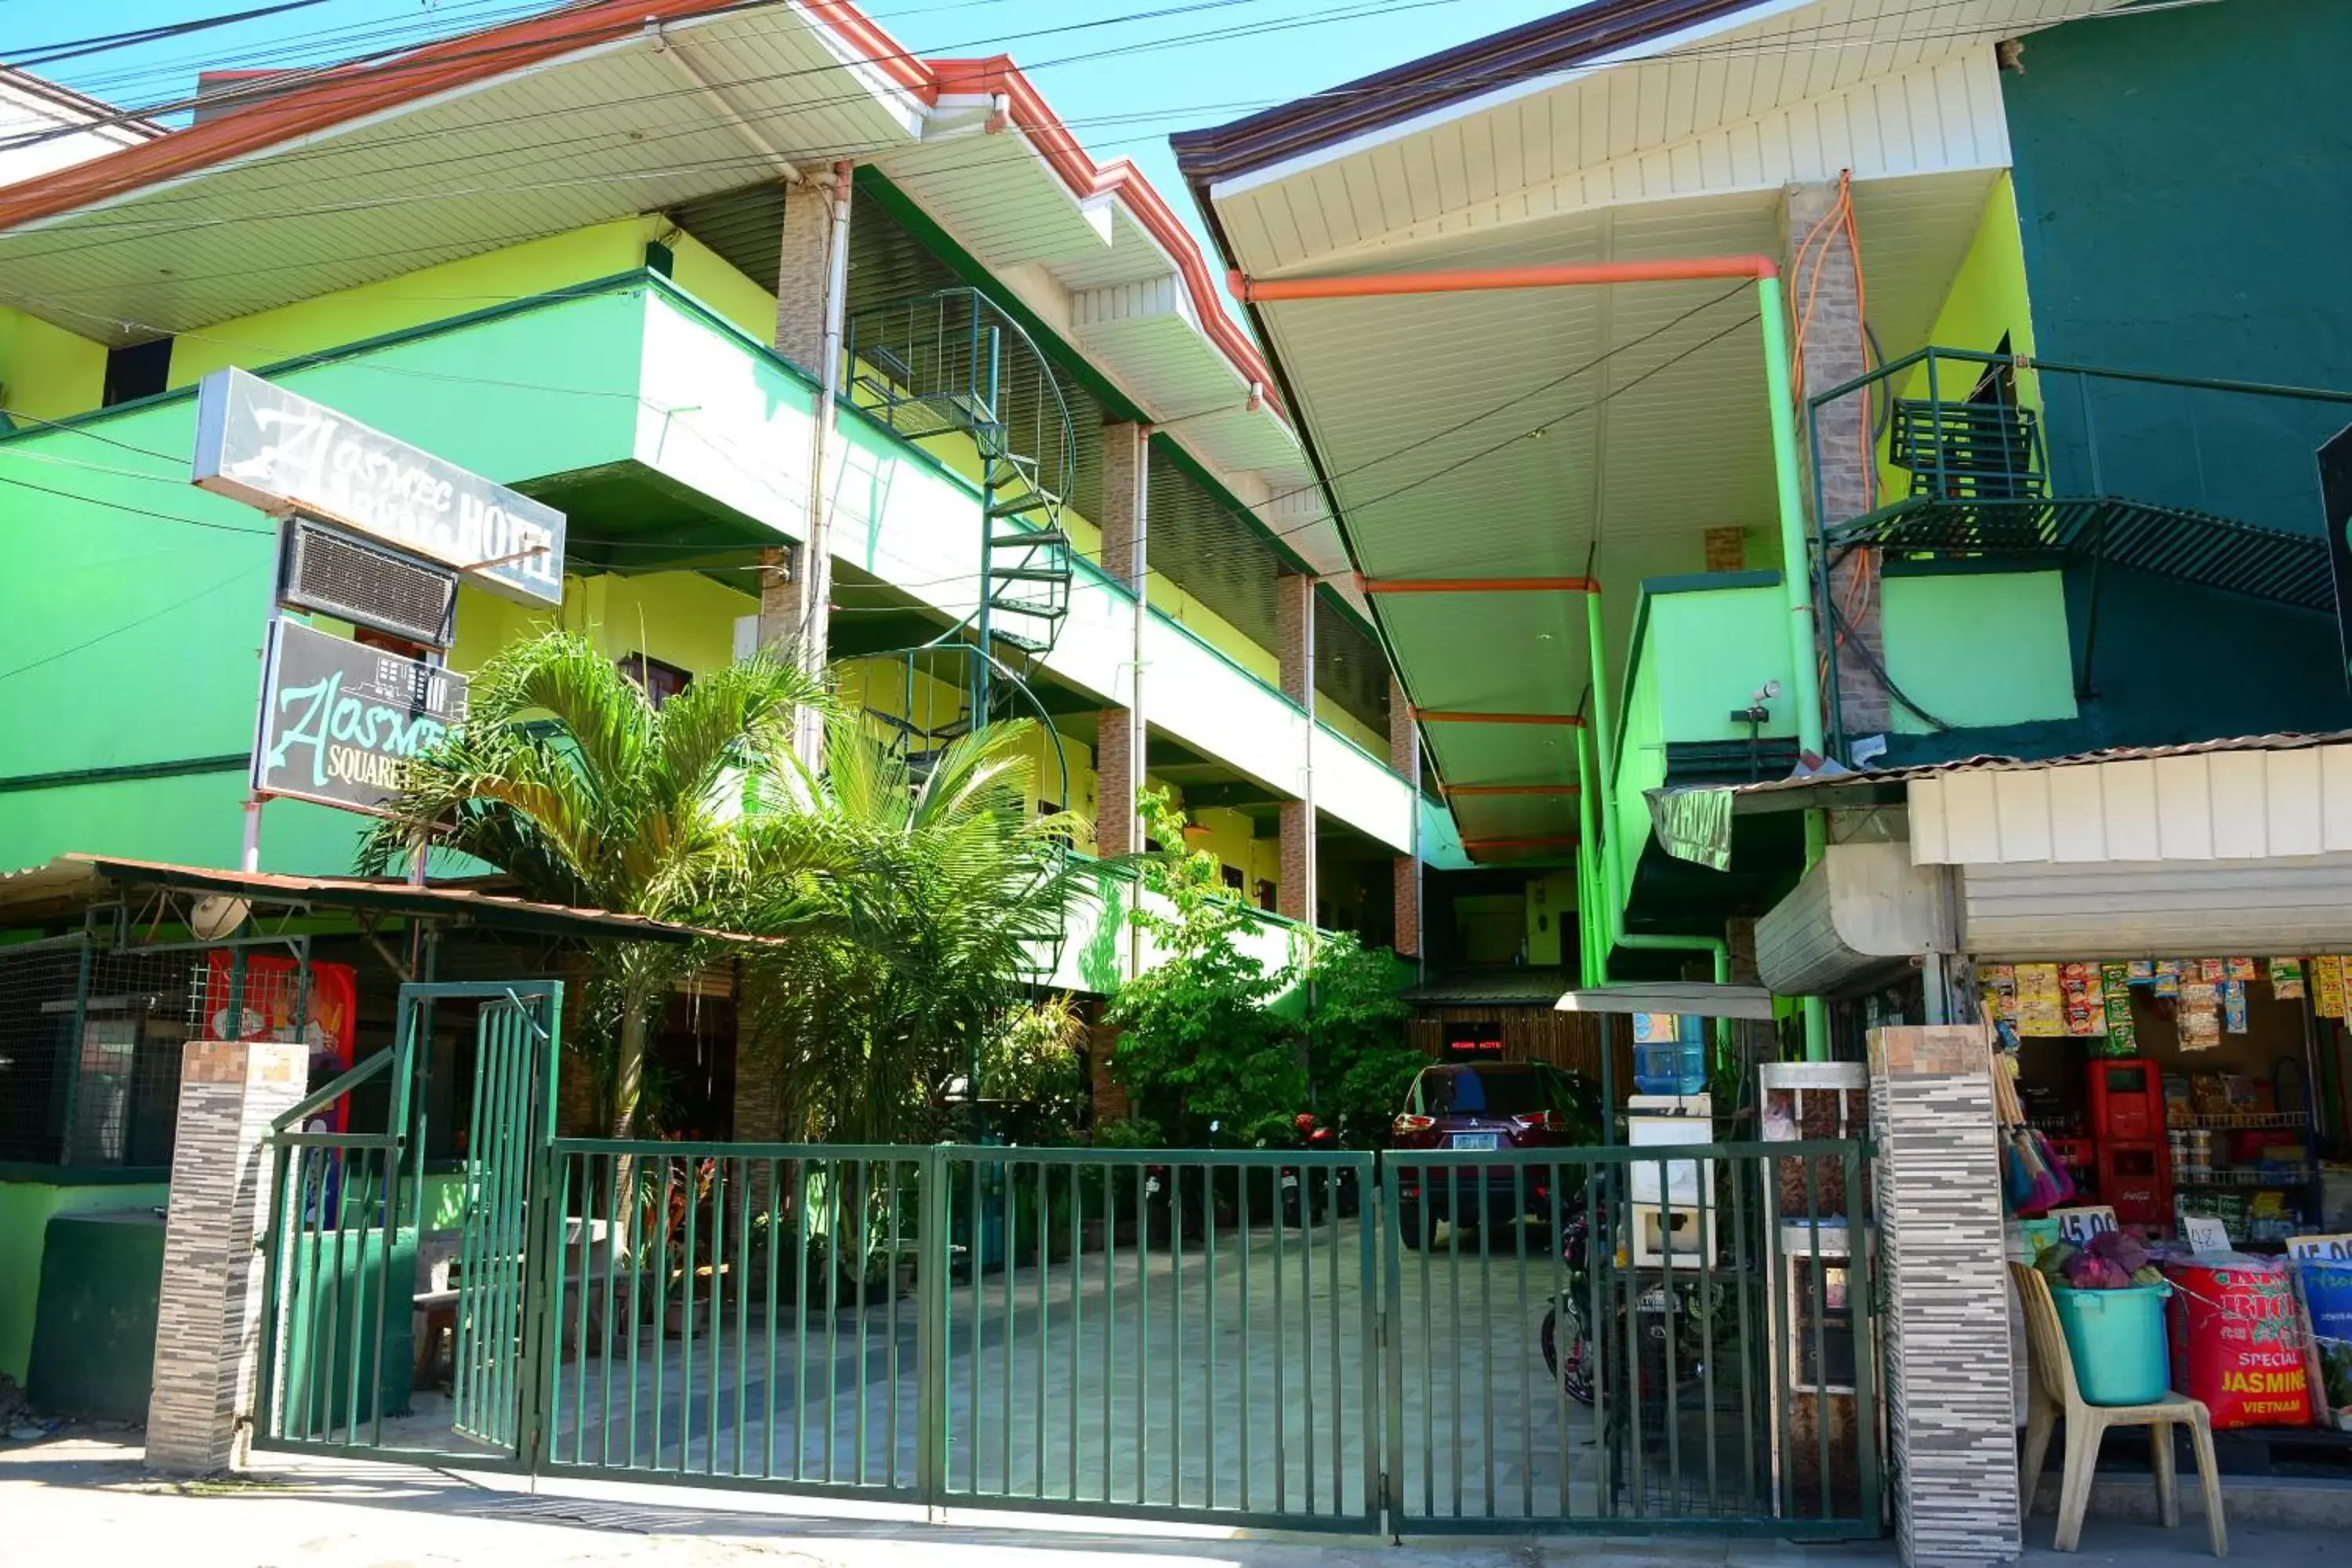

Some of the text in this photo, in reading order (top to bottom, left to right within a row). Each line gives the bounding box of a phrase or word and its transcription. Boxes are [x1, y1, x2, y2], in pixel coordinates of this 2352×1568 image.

[458, 492, 559, 586] HOTEL
[327, 744, 412, 789] SQUARE
[2238, 1352, 2299, 1367] SPECIAL
[2221, 1368, 2307, 1393] JASMINE
[2242, 1399, 2300, 1414] VIETNAM
